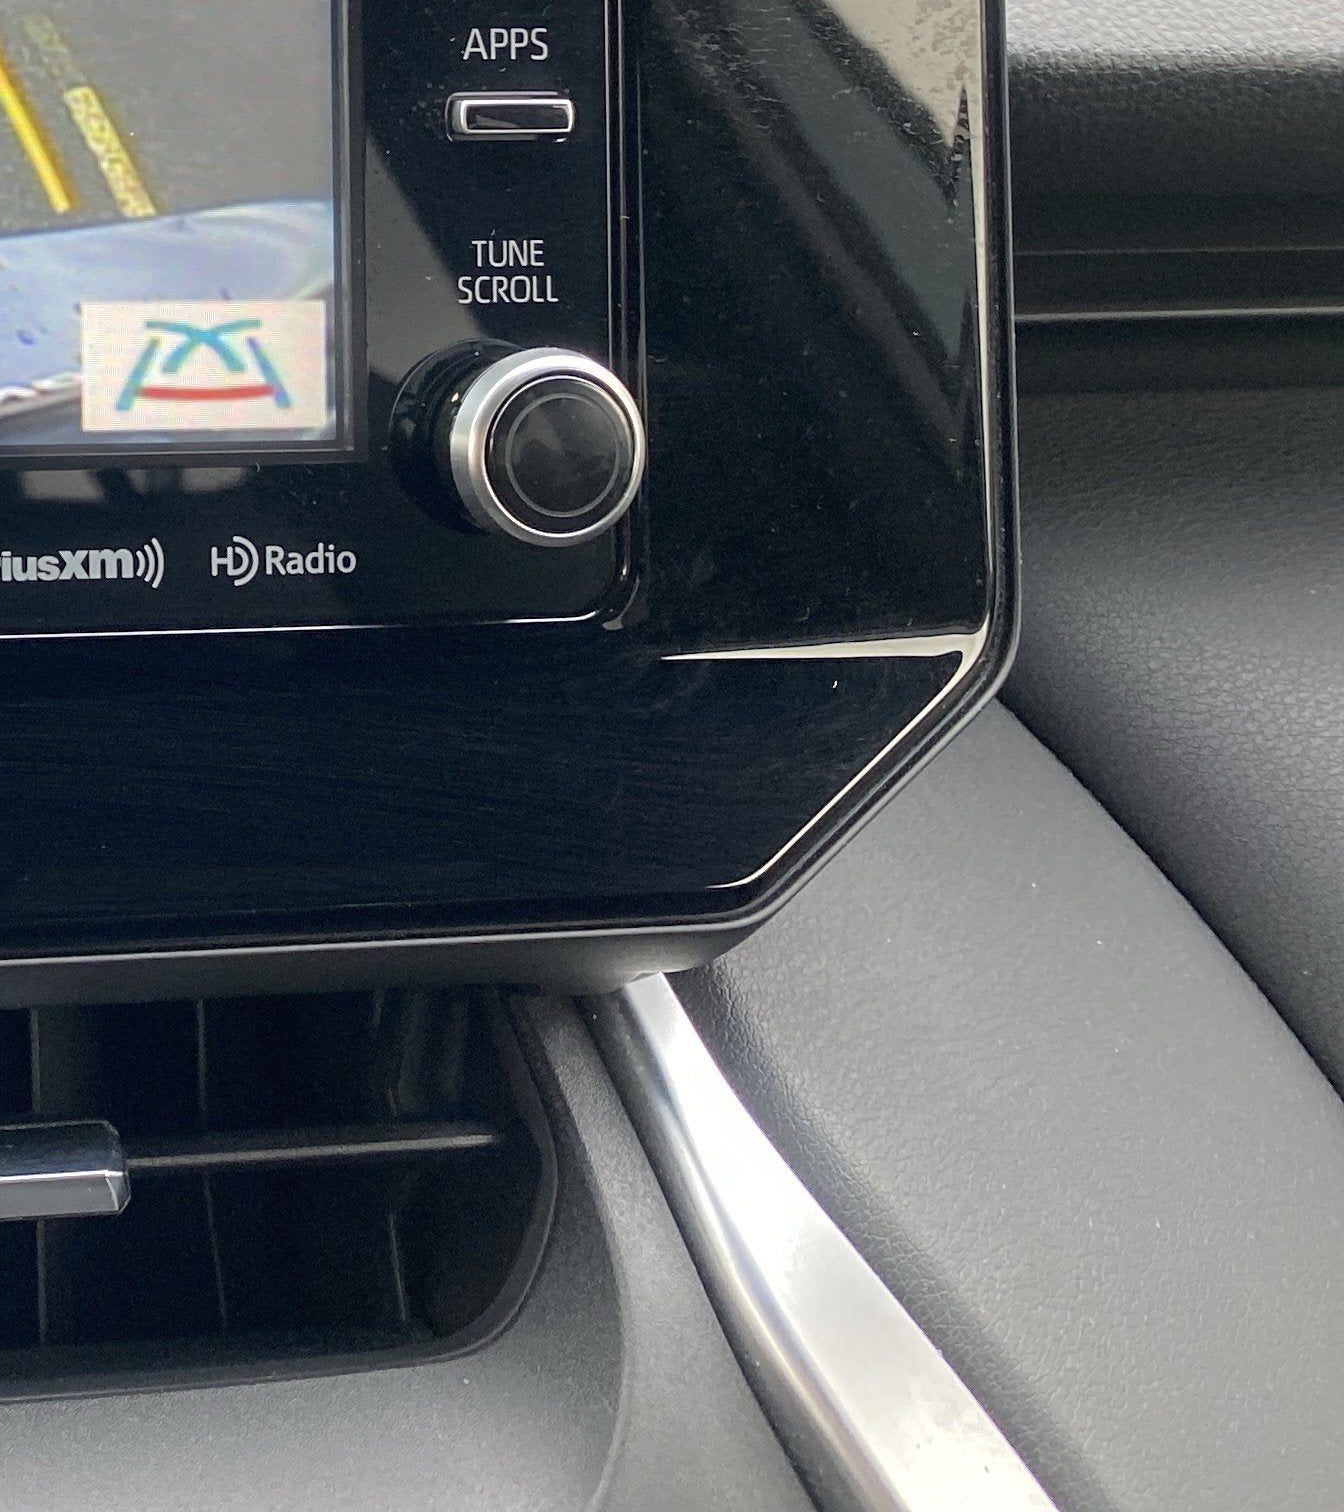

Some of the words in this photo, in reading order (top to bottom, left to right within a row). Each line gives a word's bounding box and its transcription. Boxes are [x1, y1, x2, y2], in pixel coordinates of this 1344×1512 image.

[462, 27, 549, 61] APPS
[470, 239, 545, 267] TUNE
[456, 275, 560, 304] SCROLL
[265, 541, 358, 577] Radio
